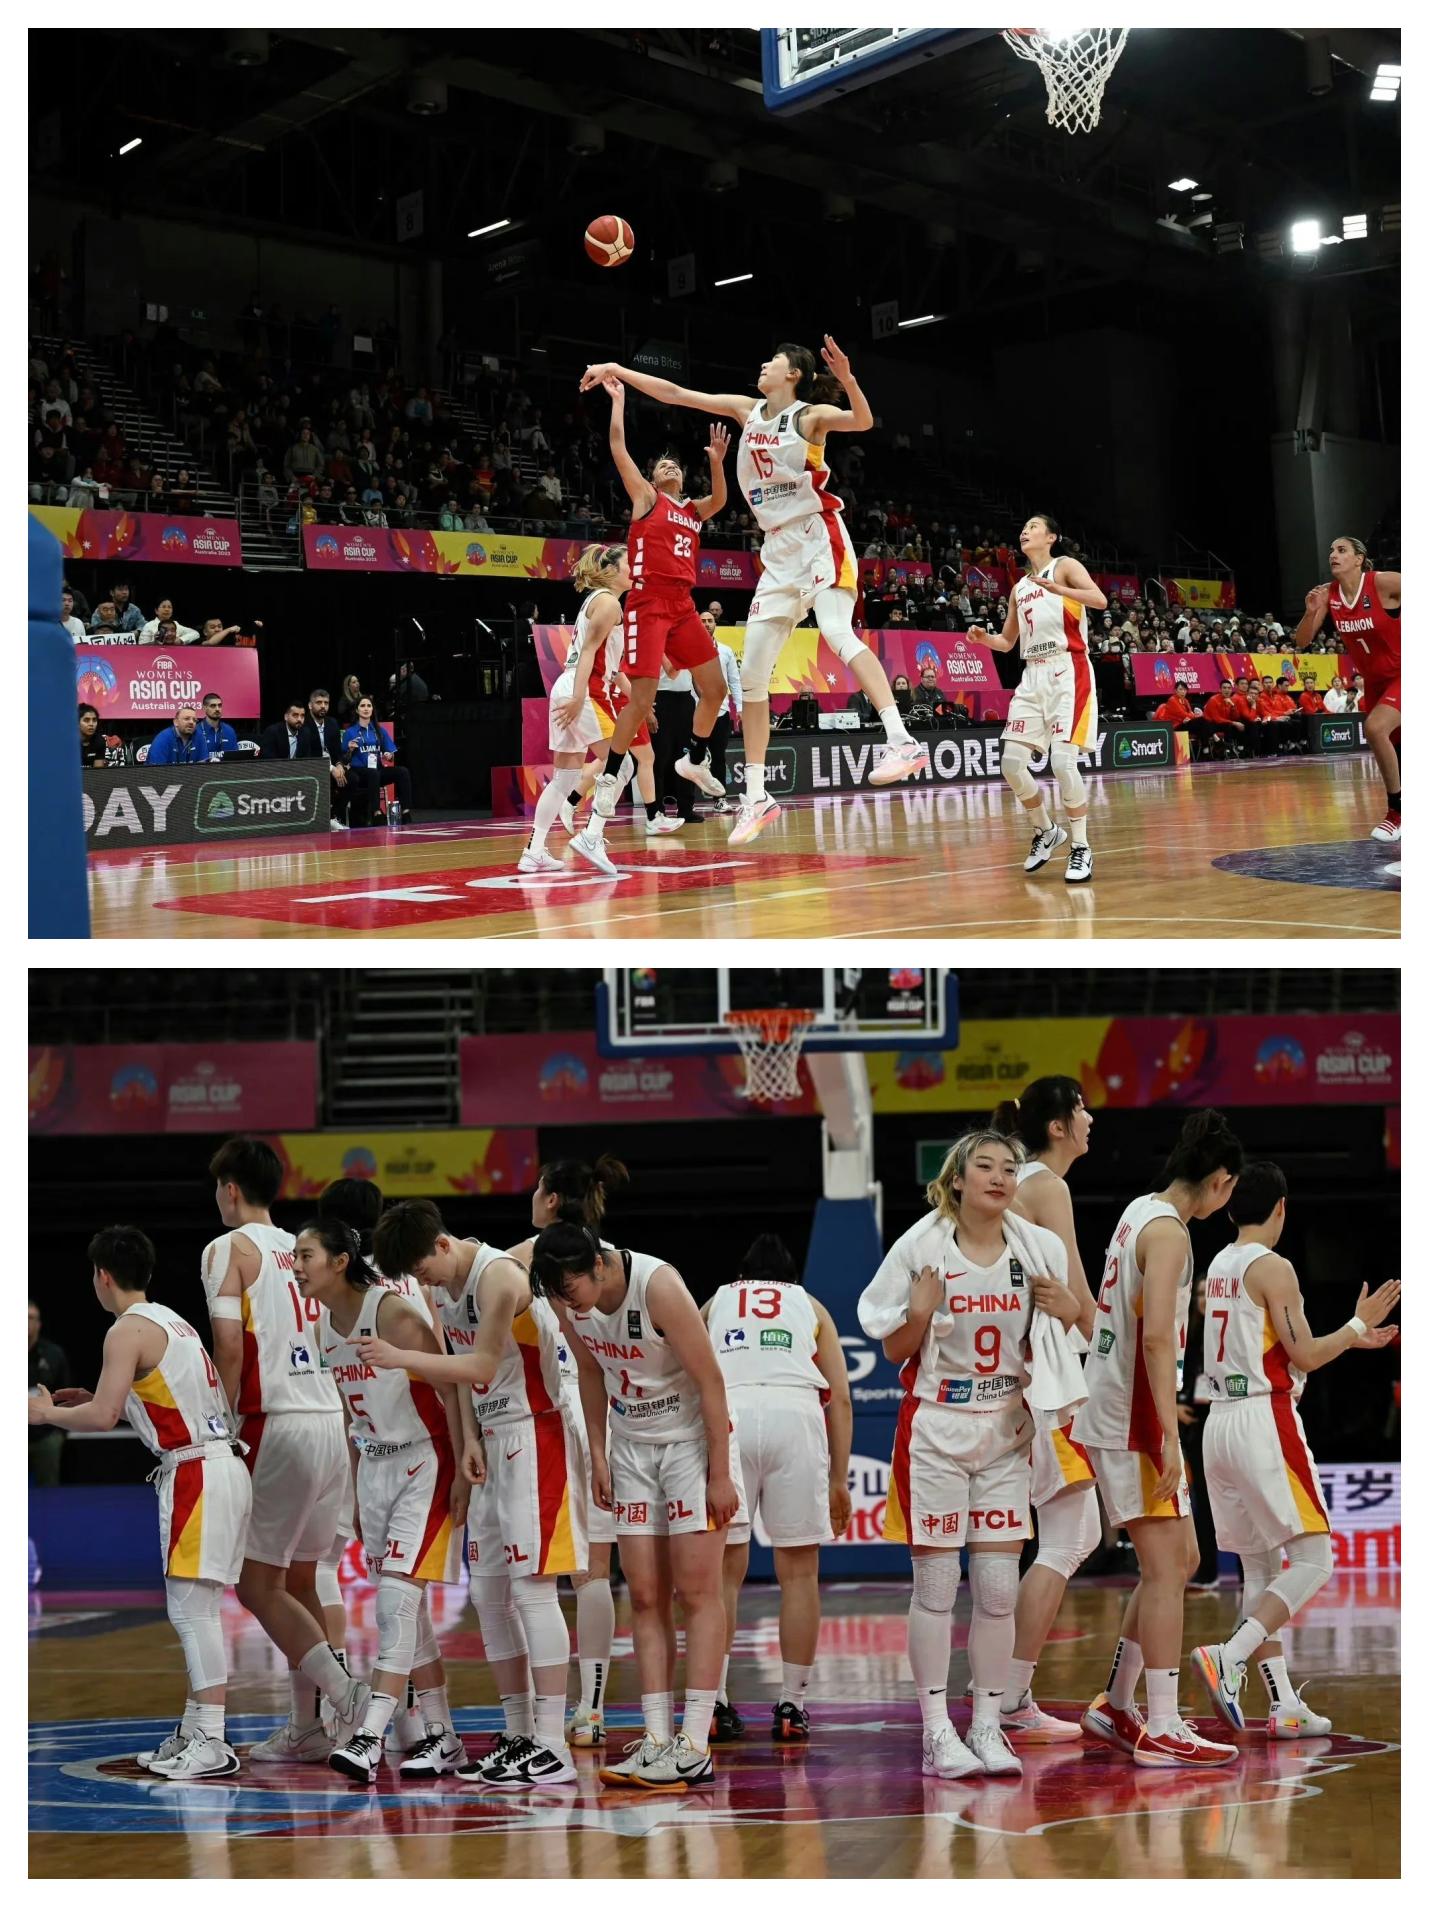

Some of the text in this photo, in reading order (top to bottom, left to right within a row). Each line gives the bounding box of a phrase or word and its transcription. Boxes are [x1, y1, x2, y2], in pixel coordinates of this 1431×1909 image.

[879, 316, 894, 333] 10
[633, 353, 682, 370] Arena Bites
[751, 448, 773, 480] 15
[193, 540, 230, 551] ASIA CUP
[344, 547, 376, 557] ASIA CUP
[674, 533, 692, 558] 23
[490, 554, 518, 563] ASIA CUP
[732, 569, 742, 577] CUP
[1024, 608, 1034, 637] 5
[1336, 617, 1374, 632] LEBANON
[157, 661, 173, 669] FIBA
[947, 660, 983, 674] ASIA CUP
[136, 670, 193, 680] WOMEN'S
[1188, 672, 1198, 683] CUP
[130, 681, 201, 700] ASIA CUP
[131, 702, 175, 710] Australia
[1331, 729, 1351, 742] Smart
[734, 760, 787, 784] Sart
[1131, 739, 1164, 757] Smart
[237, 790, 305, 816] Smart
[998, 1062, 1029, 1080] CUP
[1316, 1054, 1392, 1073] ASIA CUP
[641, 1072, 673, 1091] CUP
[209, 1084, 242, 1102] CUP
[1224, 1278, 1241, 1298] L.W.
[739, 1288, 781, 1319] 13
[950, 1294, 1021, 1313] CHINA
[1212, 1310, 1228, 1362] 7
[582, 1335, 645, 1359] CHINA
[975, 1325, 1001, 1373] 9
[333, 1364, 377, 1383] CHINA
[941, 1385, 970, 1393] UnionPay
[976, 1393, 997, 1402] China
[475, 1397, 510, 1417] 国银联
[629, 1393, 680, 1414] 中国银联
[646, 1404, 680, 1418] UnionPay
[349, 1394, 376, 1434] 5
[365, 1441, 412, 1456] 中国银
[614, 1501, 647, 1523] 中国
[969, 1510, 1022, 1529] TCL
[921, 1512, 959, 1535] 中国
